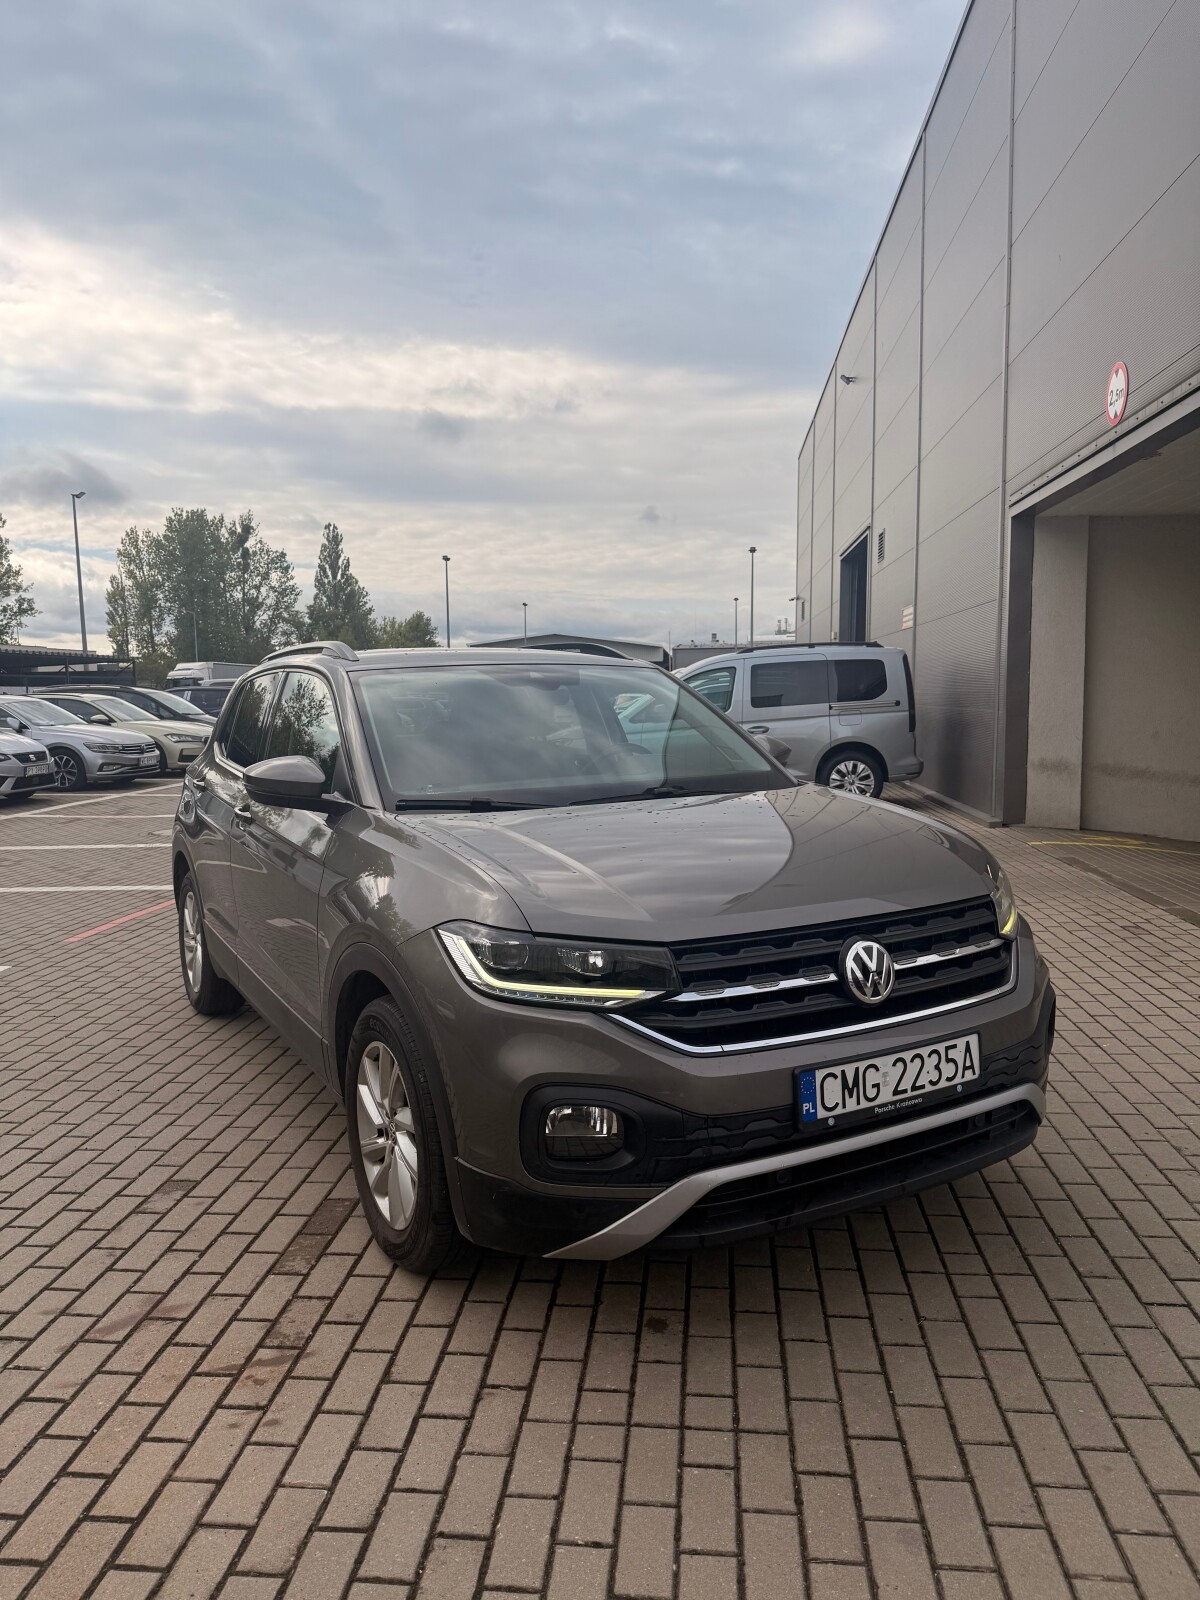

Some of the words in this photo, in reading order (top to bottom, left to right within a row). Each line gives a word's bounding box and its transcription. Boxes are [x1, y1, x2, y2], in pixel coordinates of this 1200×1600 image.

[1108, 388, 1124, 407] 2,5m
[819, 1063, 881, 1112] CMG
[891, 1040, 976, 1097] 2235A
[802, 1101, 816, 1115] PL
